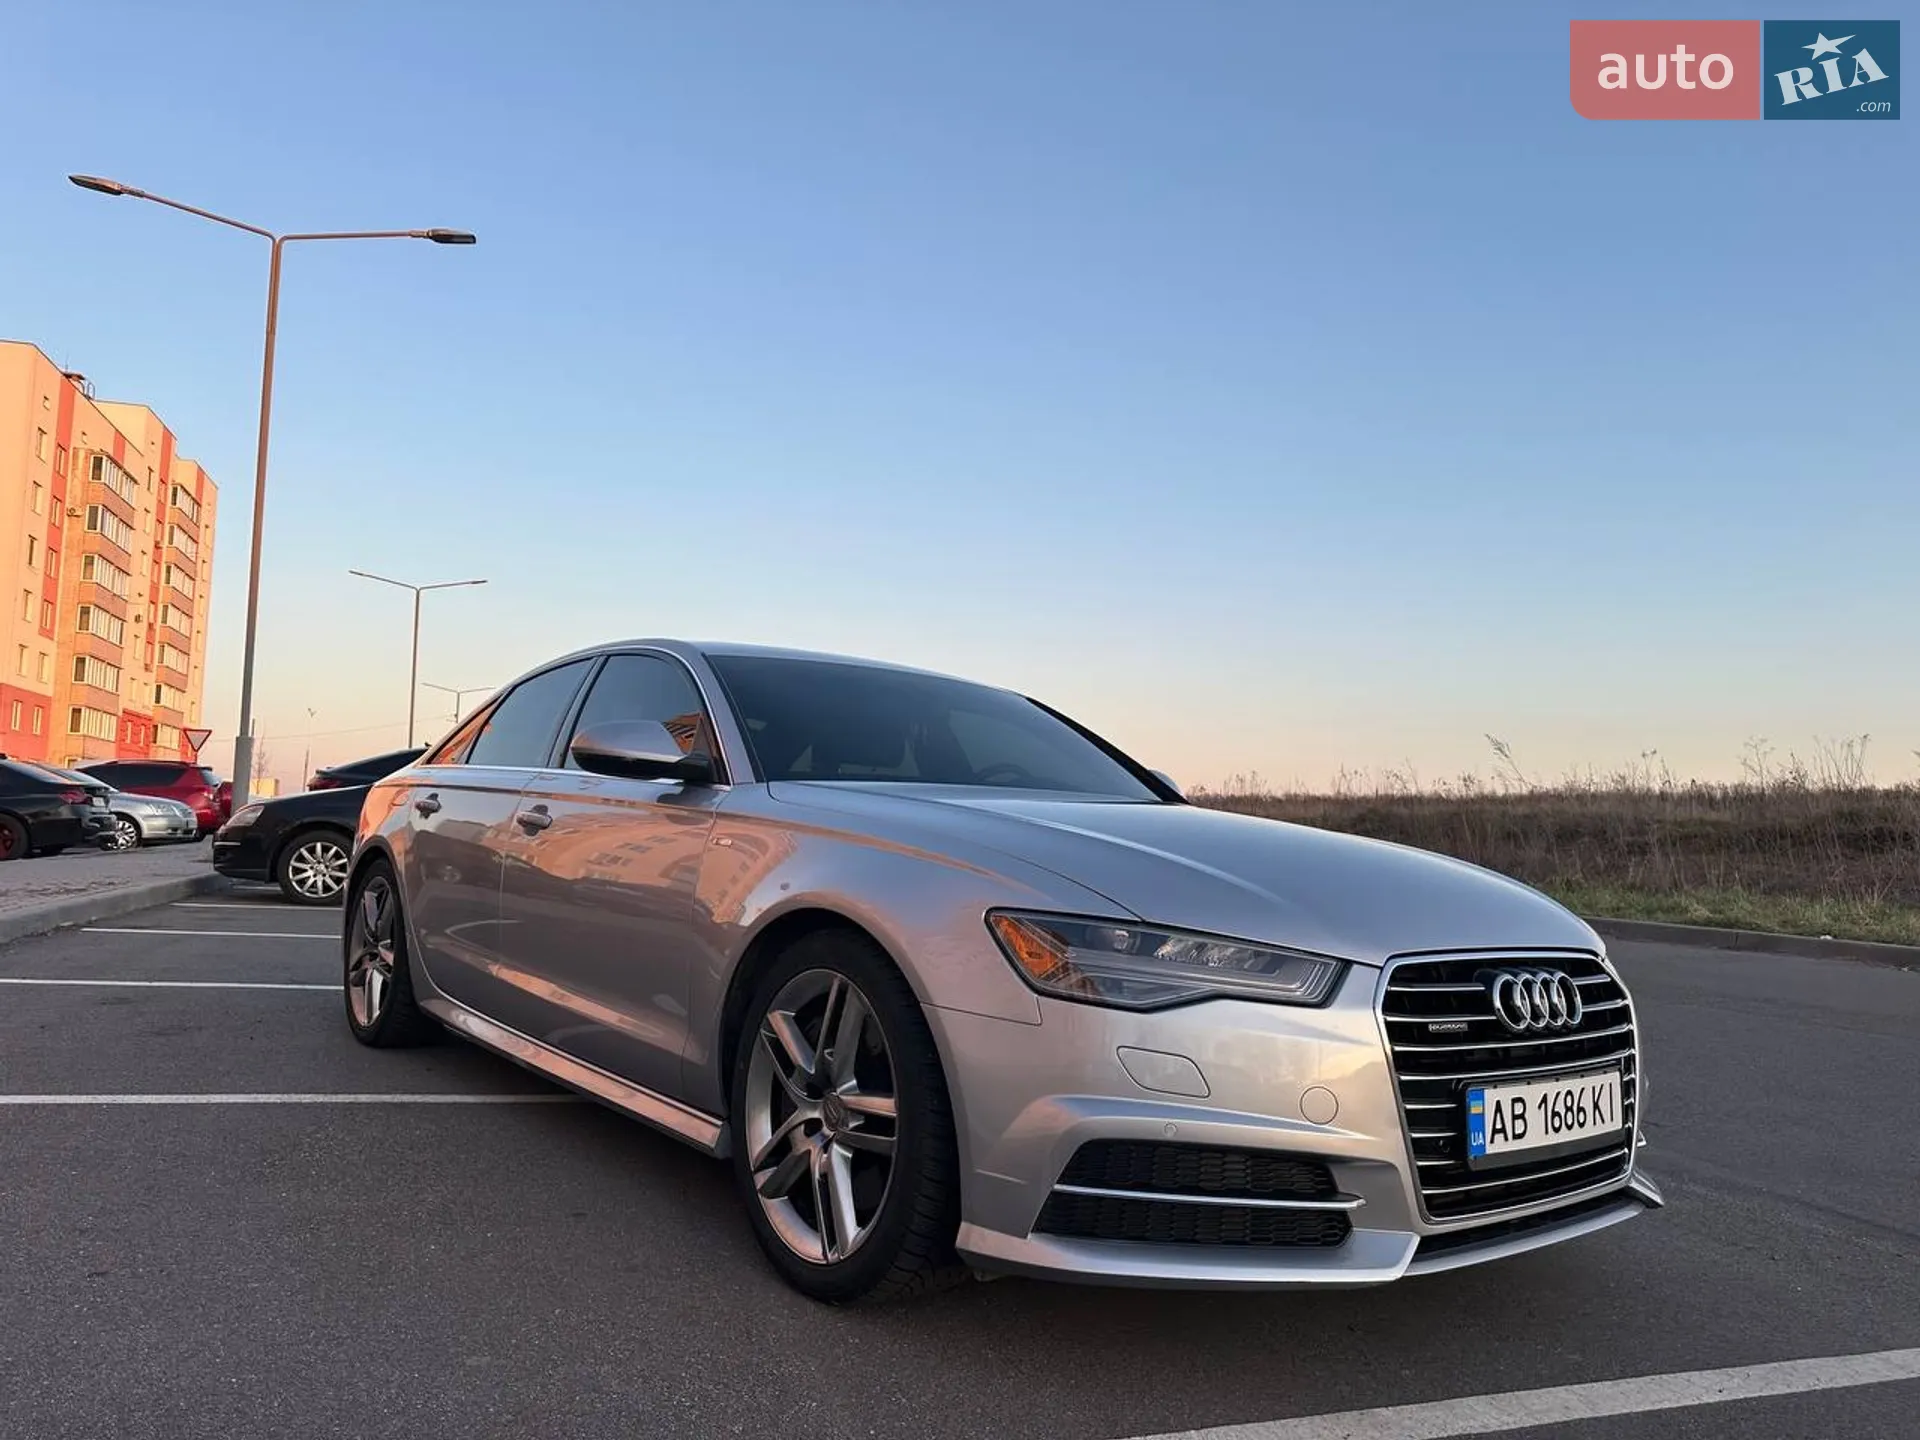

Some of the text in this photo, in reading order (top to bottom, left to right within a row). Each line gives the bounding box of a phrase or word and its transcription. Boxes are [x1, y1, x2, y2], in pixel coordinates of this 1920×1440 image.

[1489, 1081, 1614, 1144] AB 1686 KI
[1471, 1131, 1485, 1146] UA
